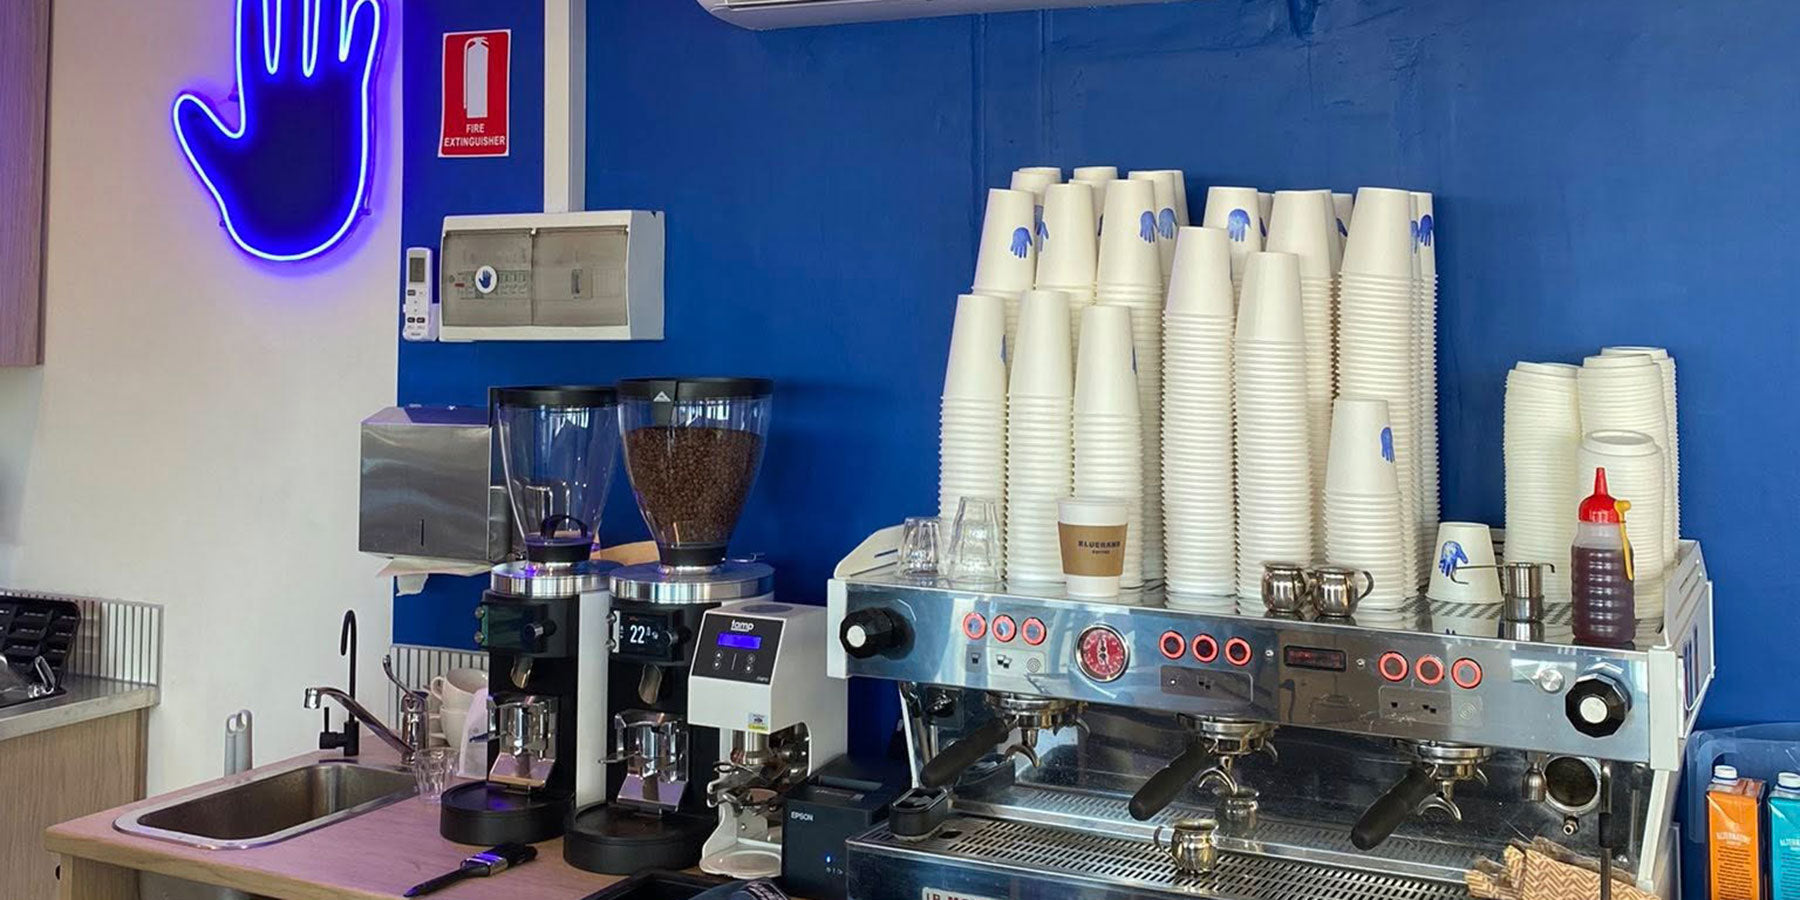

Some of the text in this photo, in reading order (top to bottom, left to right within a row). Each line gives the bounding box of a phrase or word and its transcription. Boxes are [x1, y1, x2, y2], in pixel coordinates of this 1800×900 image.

[466, 123, 485, 133] FIRE
[444, 135, 505, 147] EXTINGUISHER
[731, 619, 754, 632] tamp
[791, 811, 813, 821] EPSON
